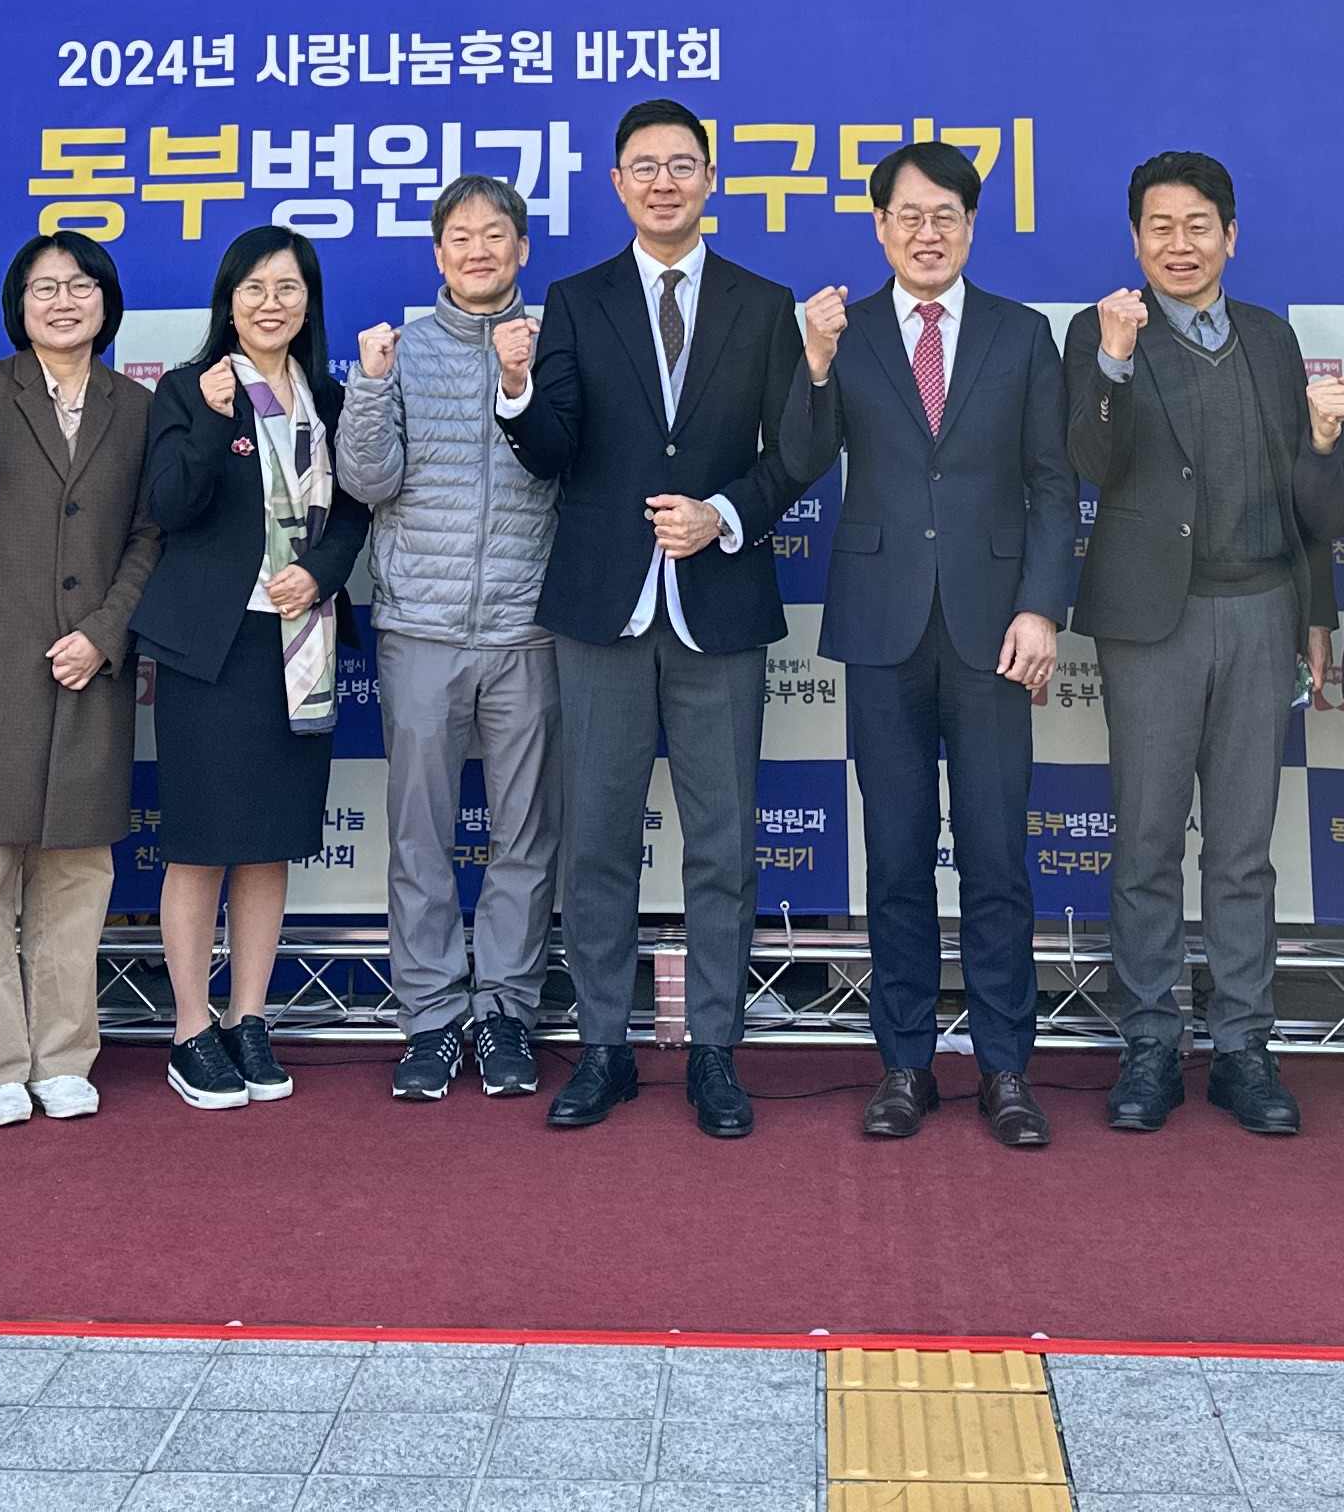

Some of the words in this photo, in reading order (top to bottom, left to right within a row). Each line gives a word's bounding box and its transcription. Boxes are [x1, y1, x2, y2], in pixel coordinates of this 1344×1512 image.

[57, 33, 236, 88] 2024년
[256, 29, 554, 87] 사랑나눔후원
[575, 28, 722, 83] 바자회
[28, 121, 583, 244] 동부병원과
[766, 659, 811, 674] 울특별시
